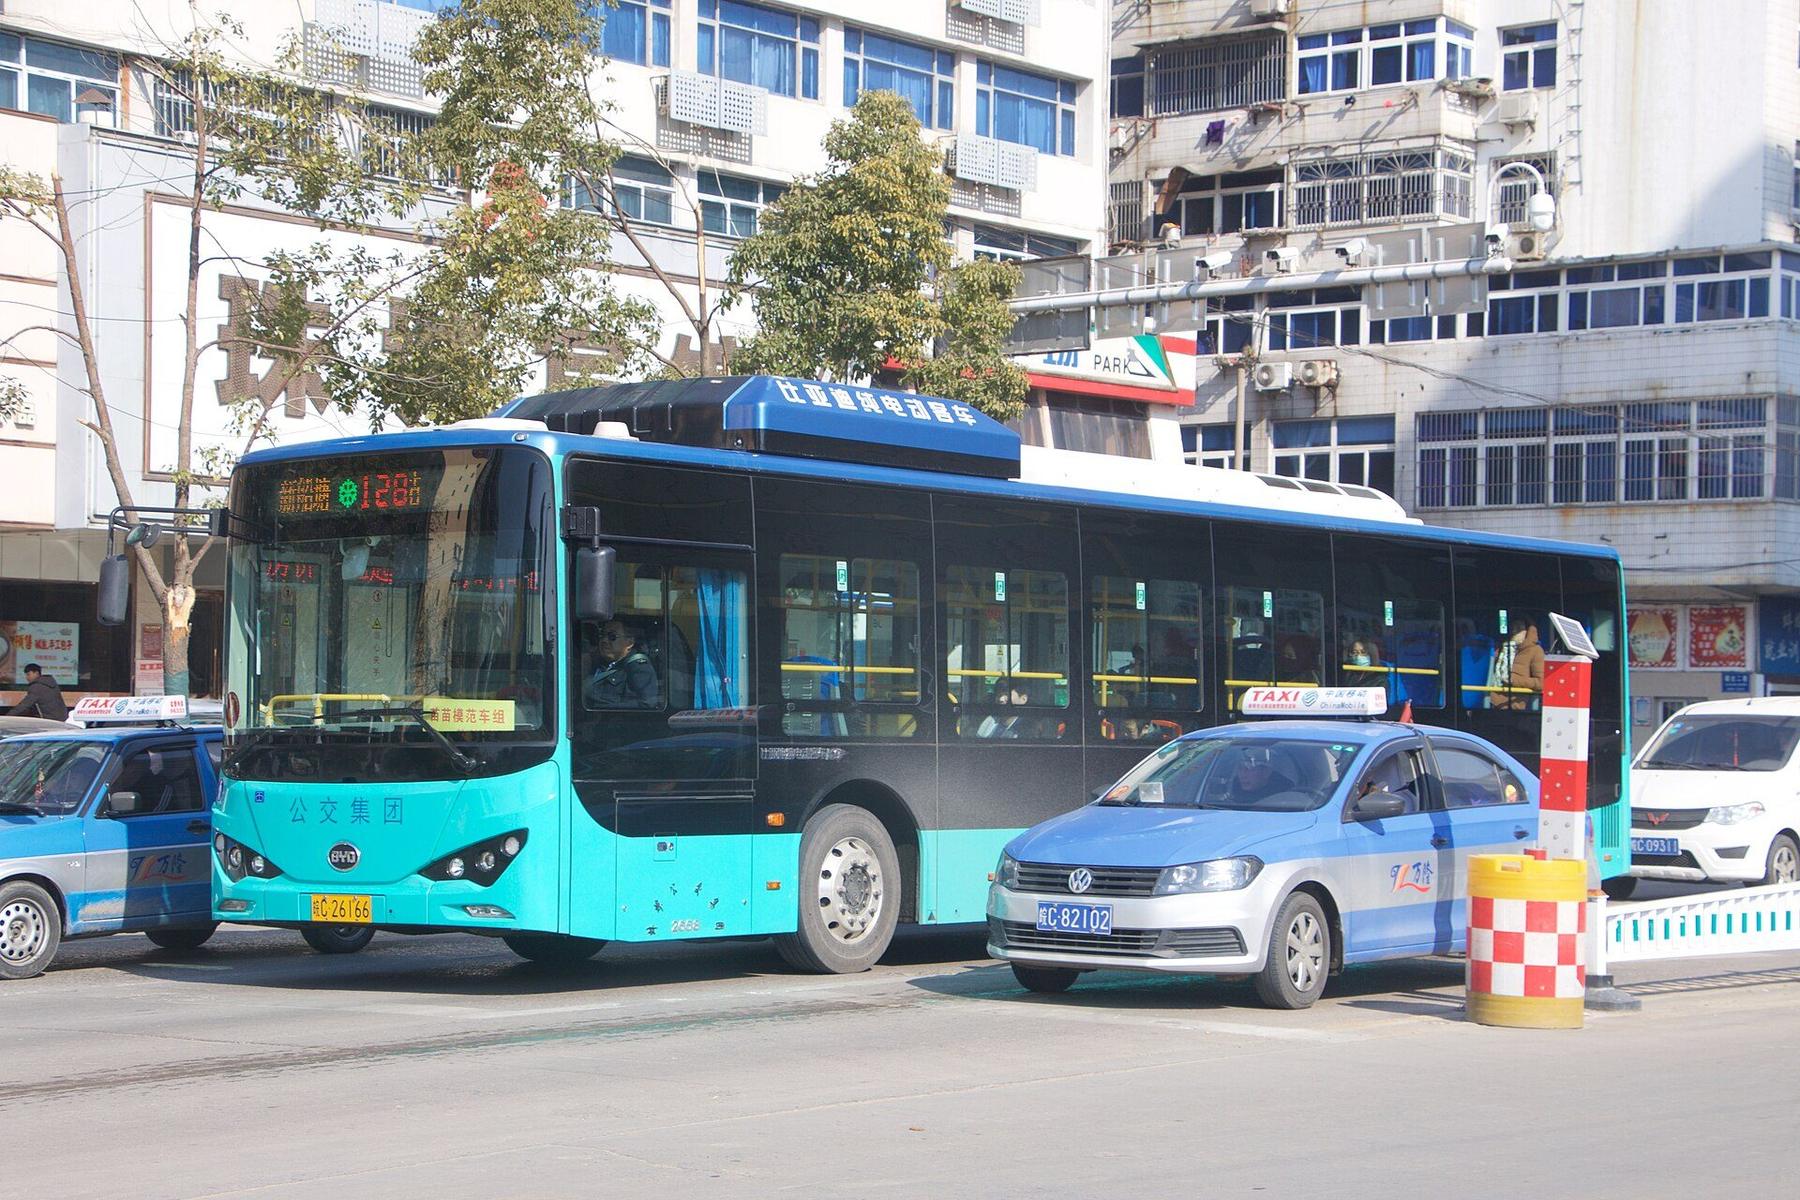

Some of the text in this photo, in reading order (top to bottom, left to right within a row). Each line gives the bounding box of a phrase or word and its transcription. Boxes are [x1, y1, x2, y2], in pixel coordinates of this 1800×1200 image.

[1094, 354, 1131, 375] PARK
[776, 380, 977, 427] 比亚迪纯电动客车
[82, 699, 117, 709] TAXI
[1253, 690, 1300, 702] TAXI
[289, 796, 403, 825] 公交集团
[330, 850, 356, 863] BYD
